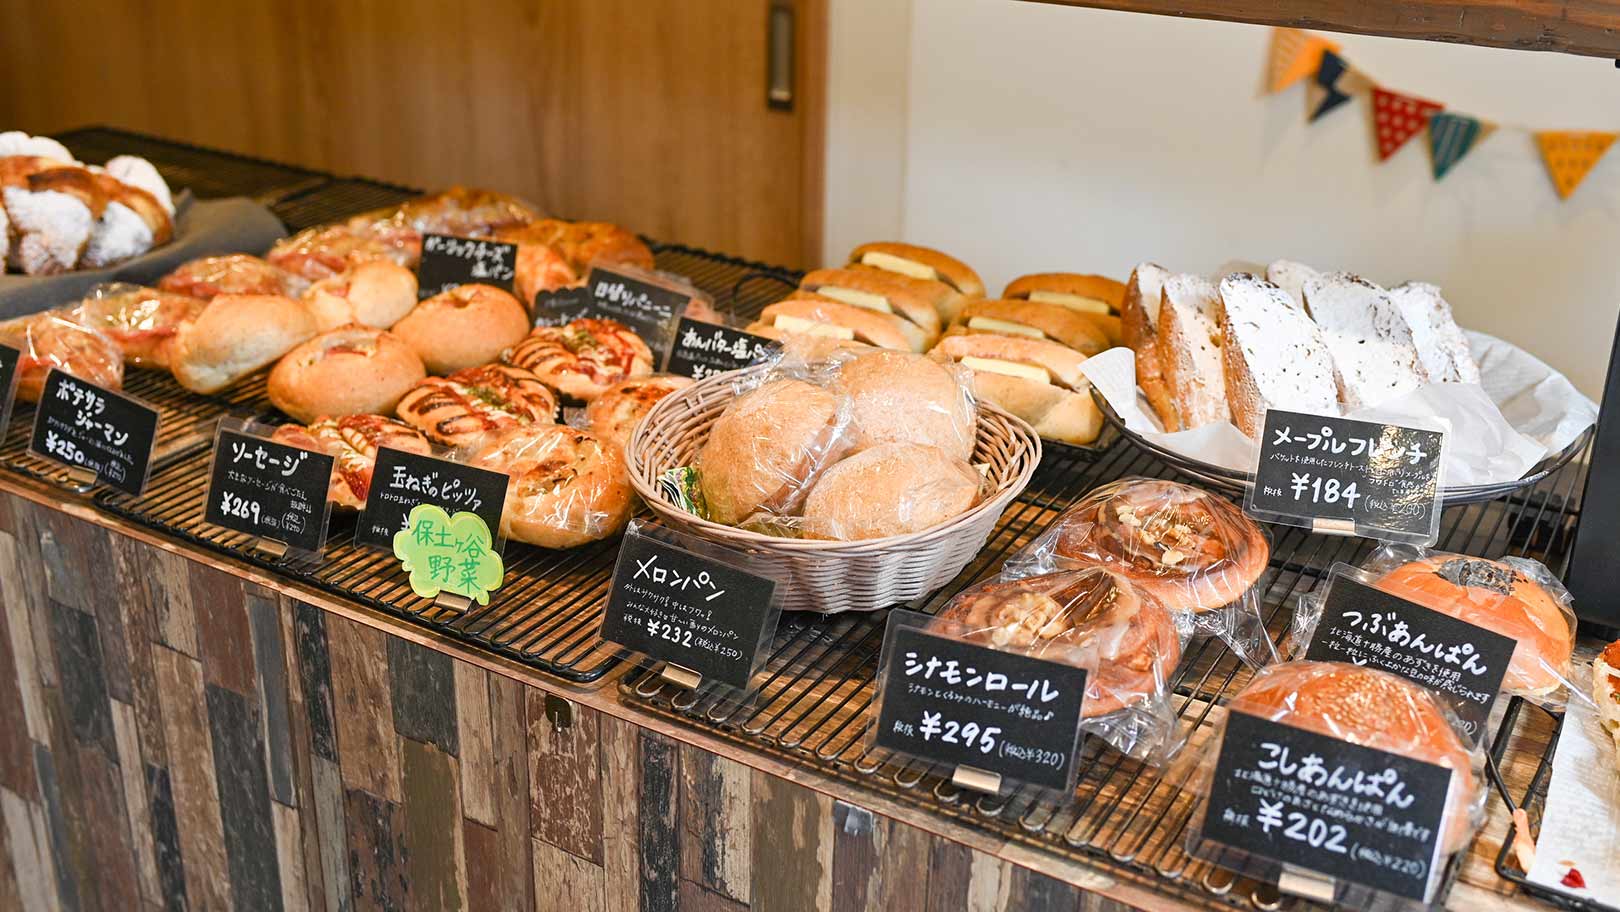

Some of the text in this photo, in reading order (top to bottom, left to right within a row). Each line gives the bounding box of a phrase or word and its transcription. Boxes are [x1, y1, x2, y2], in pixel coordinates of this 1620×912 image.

[46, 430, 85, 464] ¥250
[75, 409, 129, 446] ジャーマン
[232, 441, 309, 477] ソーセージ
[220, 490, 261, 525] ¥269
[389, 465, 482, 511] 玉ねぎのピッツァ
[1291, 472, 1360, 509] ¥184
[412, 519, 487, 560] 保土ヶ谷
[428, 554, 481, 594] 野菜
[633, 554, 726, 602] メロンパン
[647, 618, 693, 649] ¥232
[1342, 610, 1488, 676] つぶあんぱん
[905, 652, 1060, 703] シナモンロール
[919, 710, 1002, 754] ¥295
[1258, 742, 1415, 810] こしあんぱん
[1256, 798, 1348, 854] ¥202
